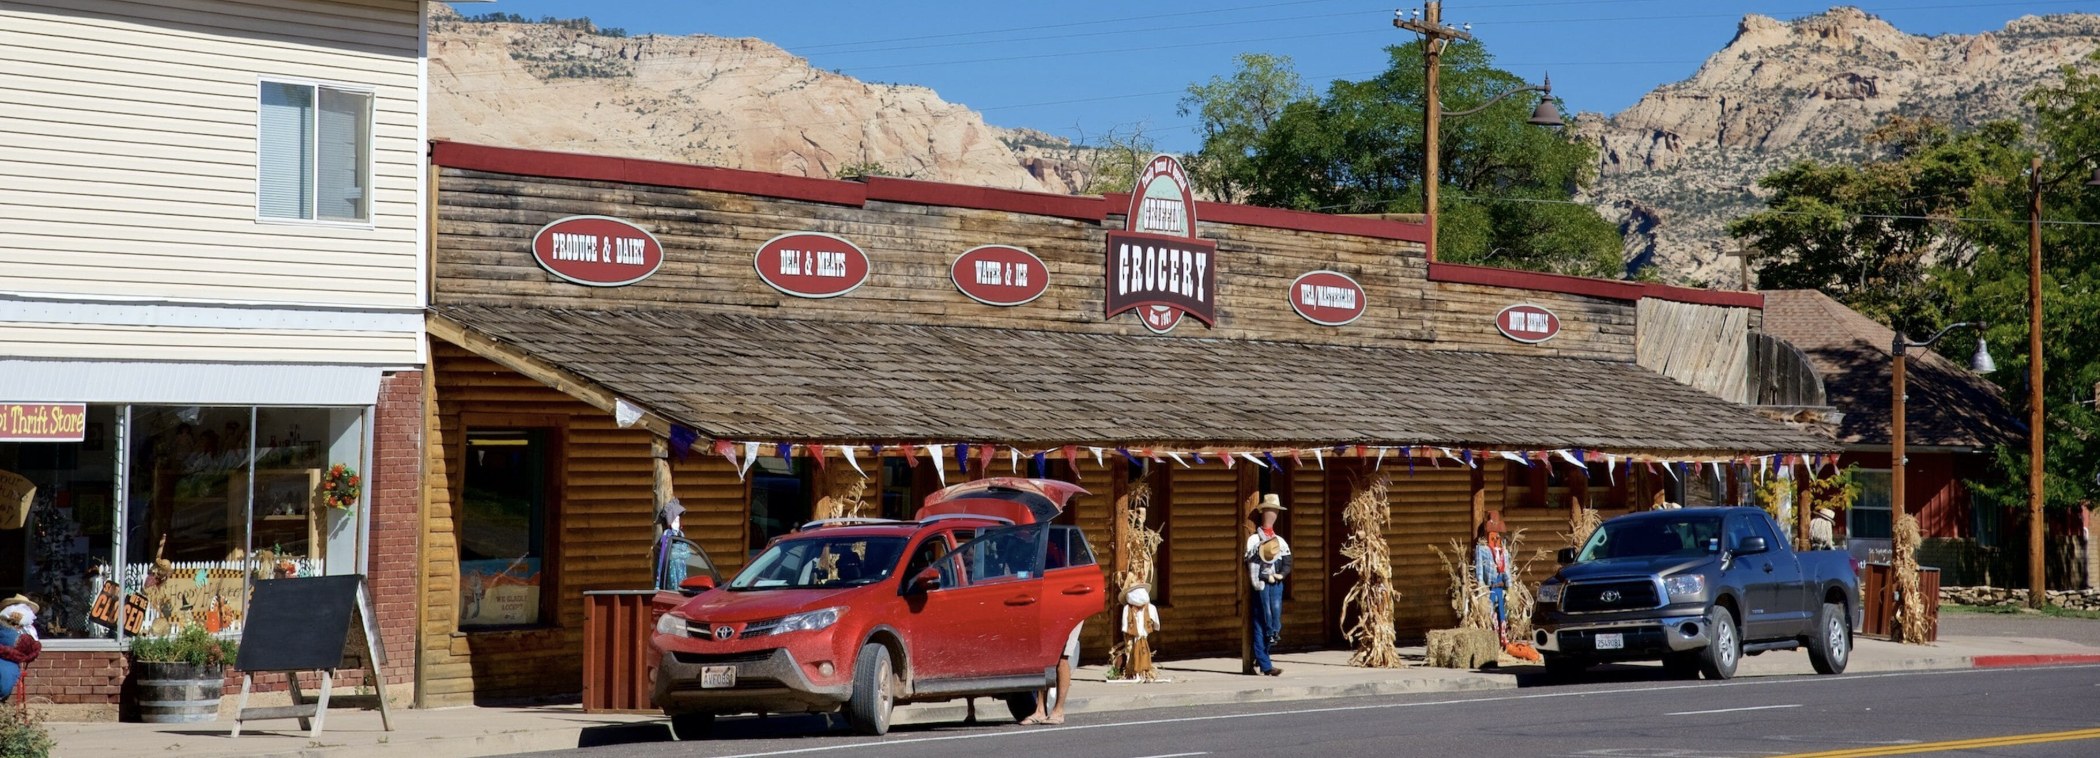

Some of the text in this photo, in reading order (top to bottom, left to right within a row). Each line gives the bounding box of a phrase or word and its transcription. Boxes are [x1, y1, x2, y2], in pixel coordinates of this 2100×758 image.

[1144, 198, 1182, 231] GRIFFIN
[552, 232, 645, 265] PRODUCE & DAIRY
[780, 249, 846, 277] DELI & MEATS
[975, 260, 1028, 287] WATER & ICE
[1119, 244, 1207, 303] GROCERY
[1300, 283, 1356, 311] VISA/MASTERCARD
[1526, 312, 1549, 334] RENTALS
[10, 405, 48, 435] Thrift
[50, 406, 85, 435] Store
